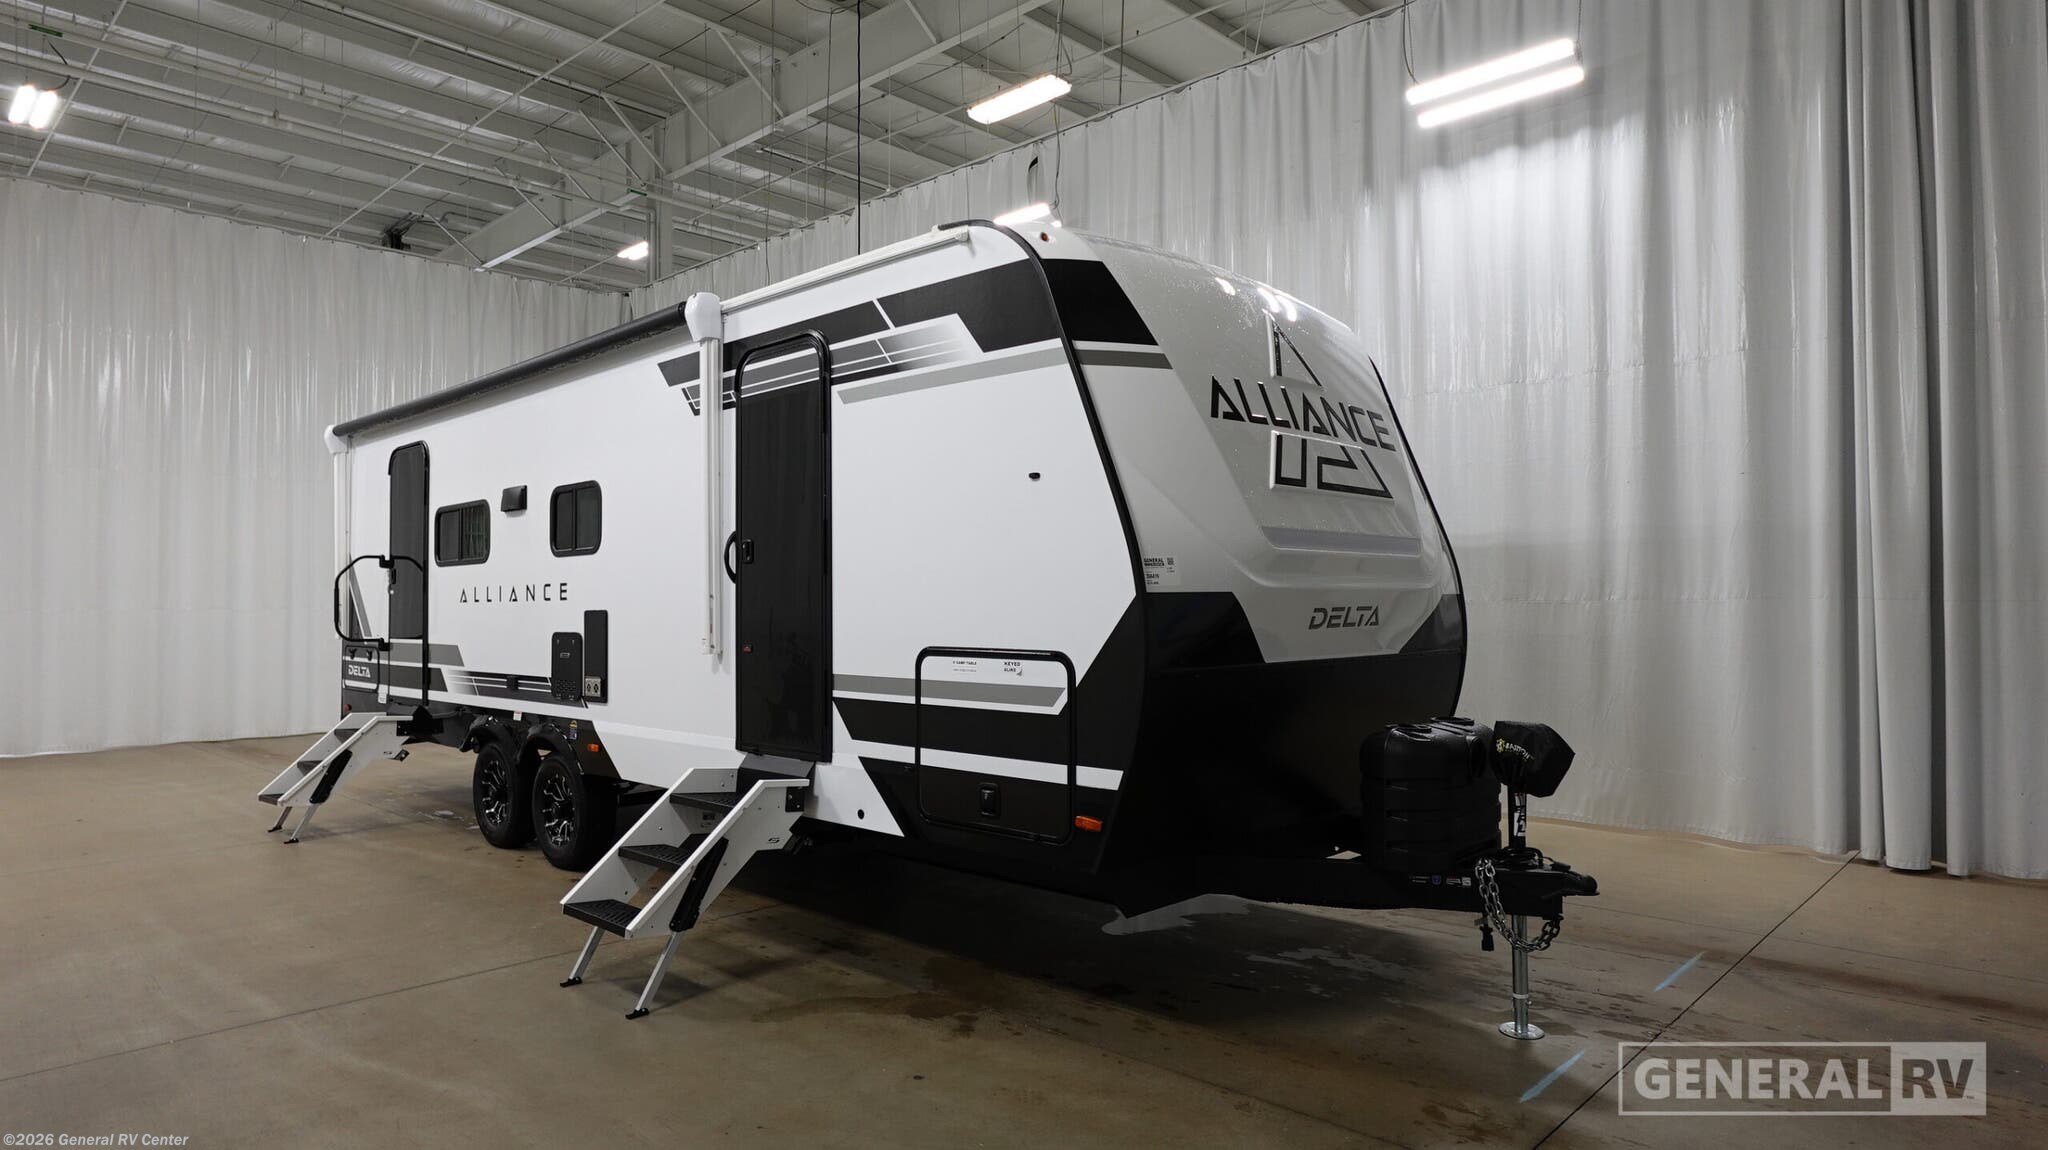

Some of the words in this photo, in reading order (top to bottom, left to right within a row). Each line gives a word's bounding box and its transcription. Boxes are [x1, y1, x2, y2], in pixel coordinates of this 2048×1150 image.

[1210, 375, 1396, 451] ALLIANCE
[459, 582, 568, 603] ALLIANCE
[1308, 606, 1380, 630] DELTA
[348, 665, 371, 678] DELTA
